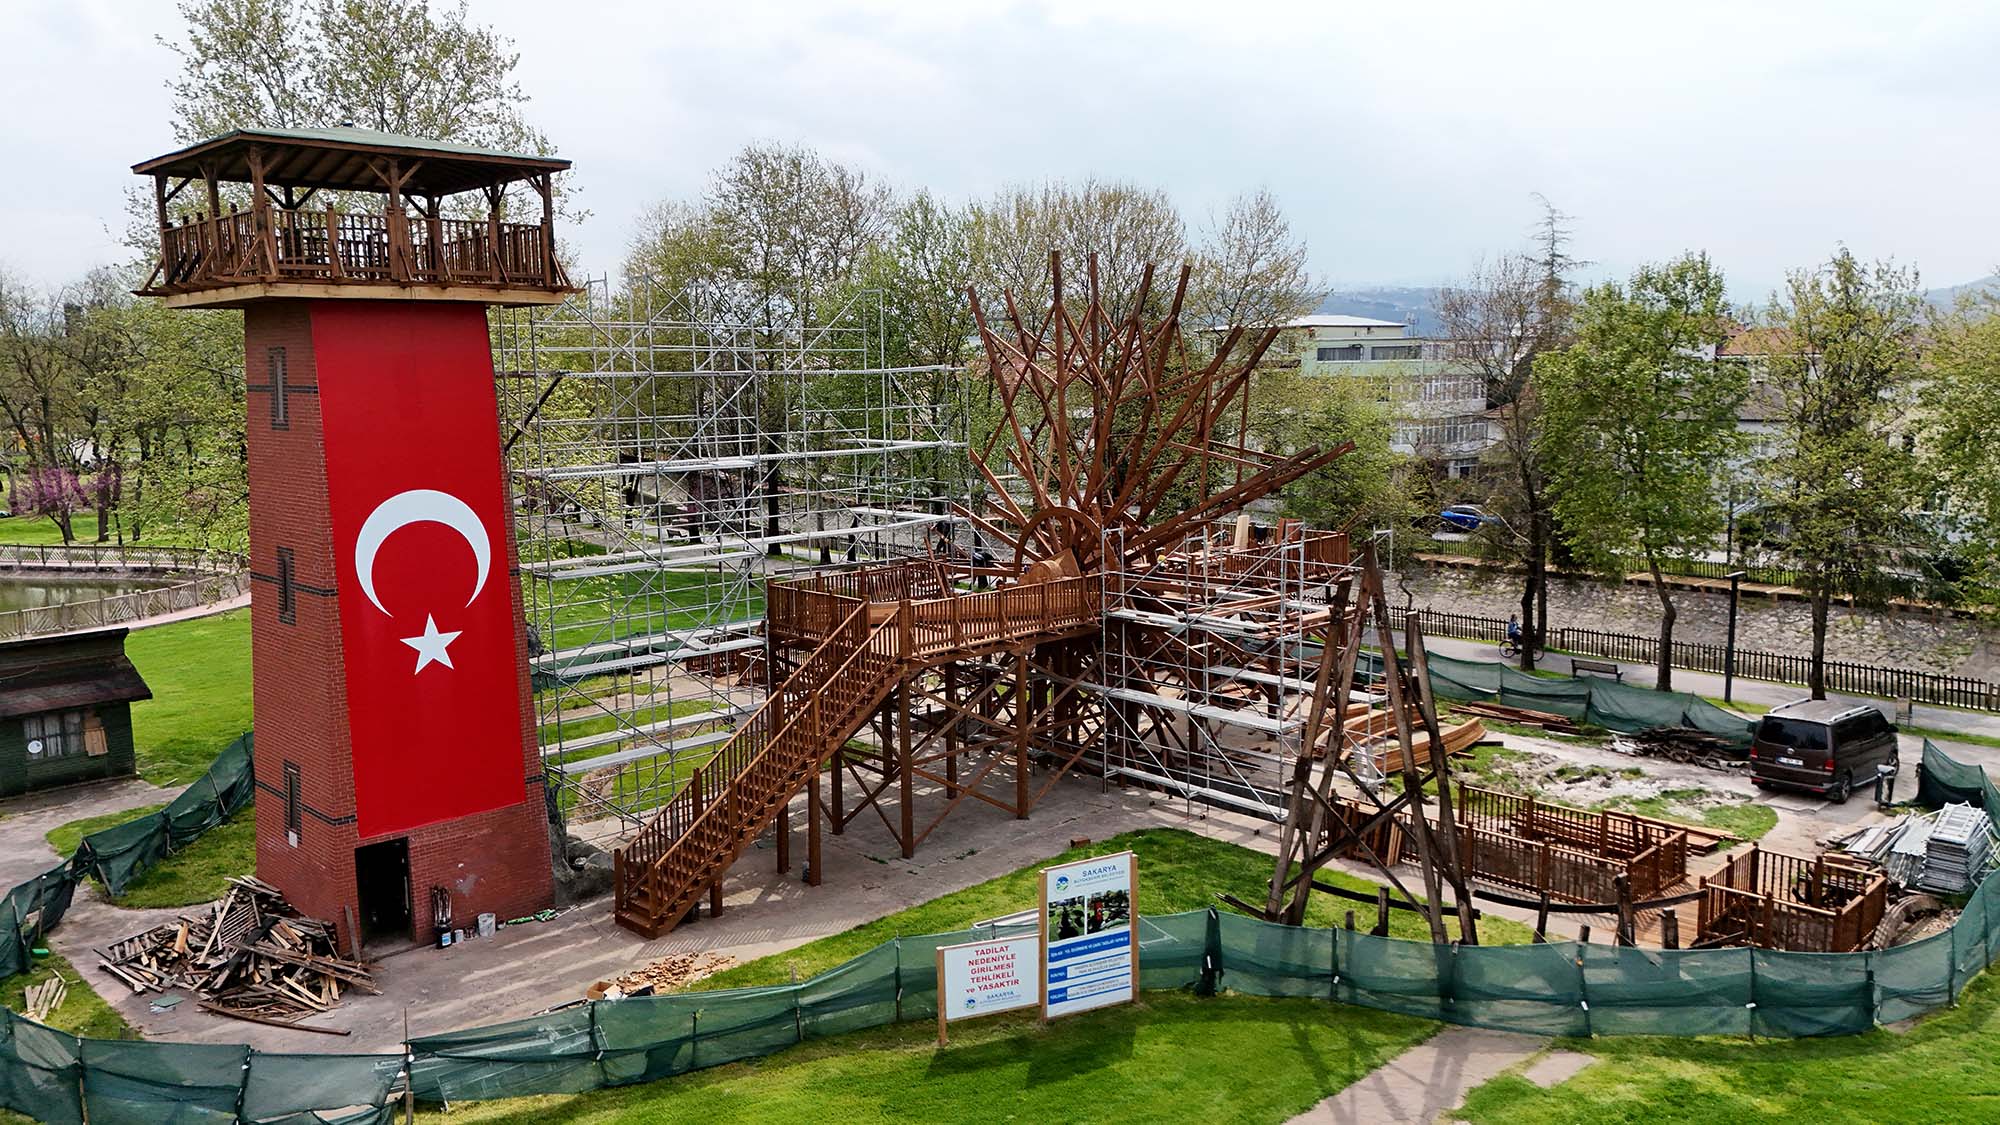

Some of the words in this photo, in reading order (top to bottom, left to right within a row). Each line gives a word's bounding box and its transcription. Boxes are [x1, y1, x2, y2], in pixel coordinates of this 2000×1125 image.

[1082, 865, 1116, 877] SAKARYA
[975, 945, 1009, 956] TADİLAT
[968, 953, 1016, 966] NEDENİYLE
[970, 962, 1014, 974] GİRİLMESİ
[970, 970, 1015, 983] TEHLİKELİ
[978, 979, 1019, 991] YASAKTIR
